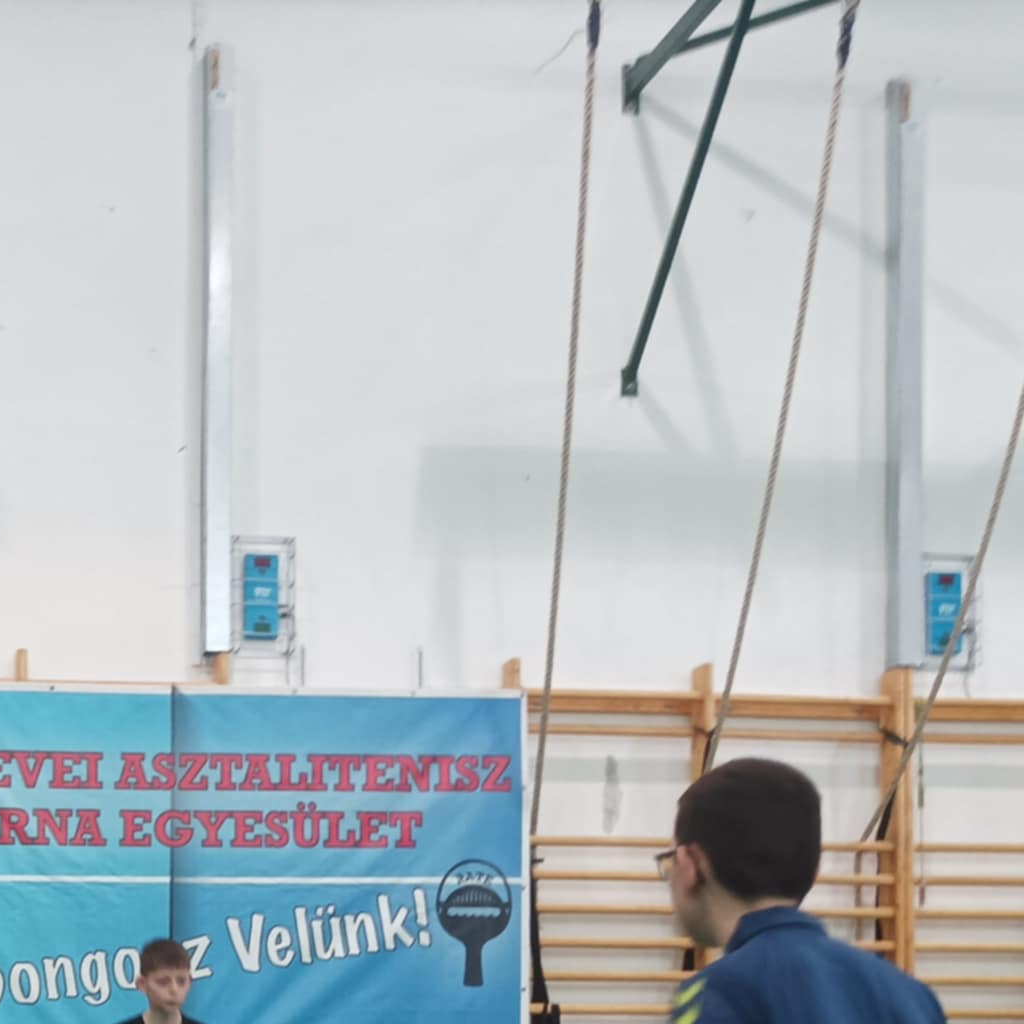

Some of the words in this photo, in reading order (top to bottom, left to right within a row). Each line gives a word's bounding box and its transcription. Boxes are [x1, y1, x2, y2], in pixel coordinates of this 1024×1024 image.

[114, 752, 512, 792] ASZTALITENISZ
[119, 801, 423, 848] EGYESÜLET
[226, 887, 432, 973] Velünk!
